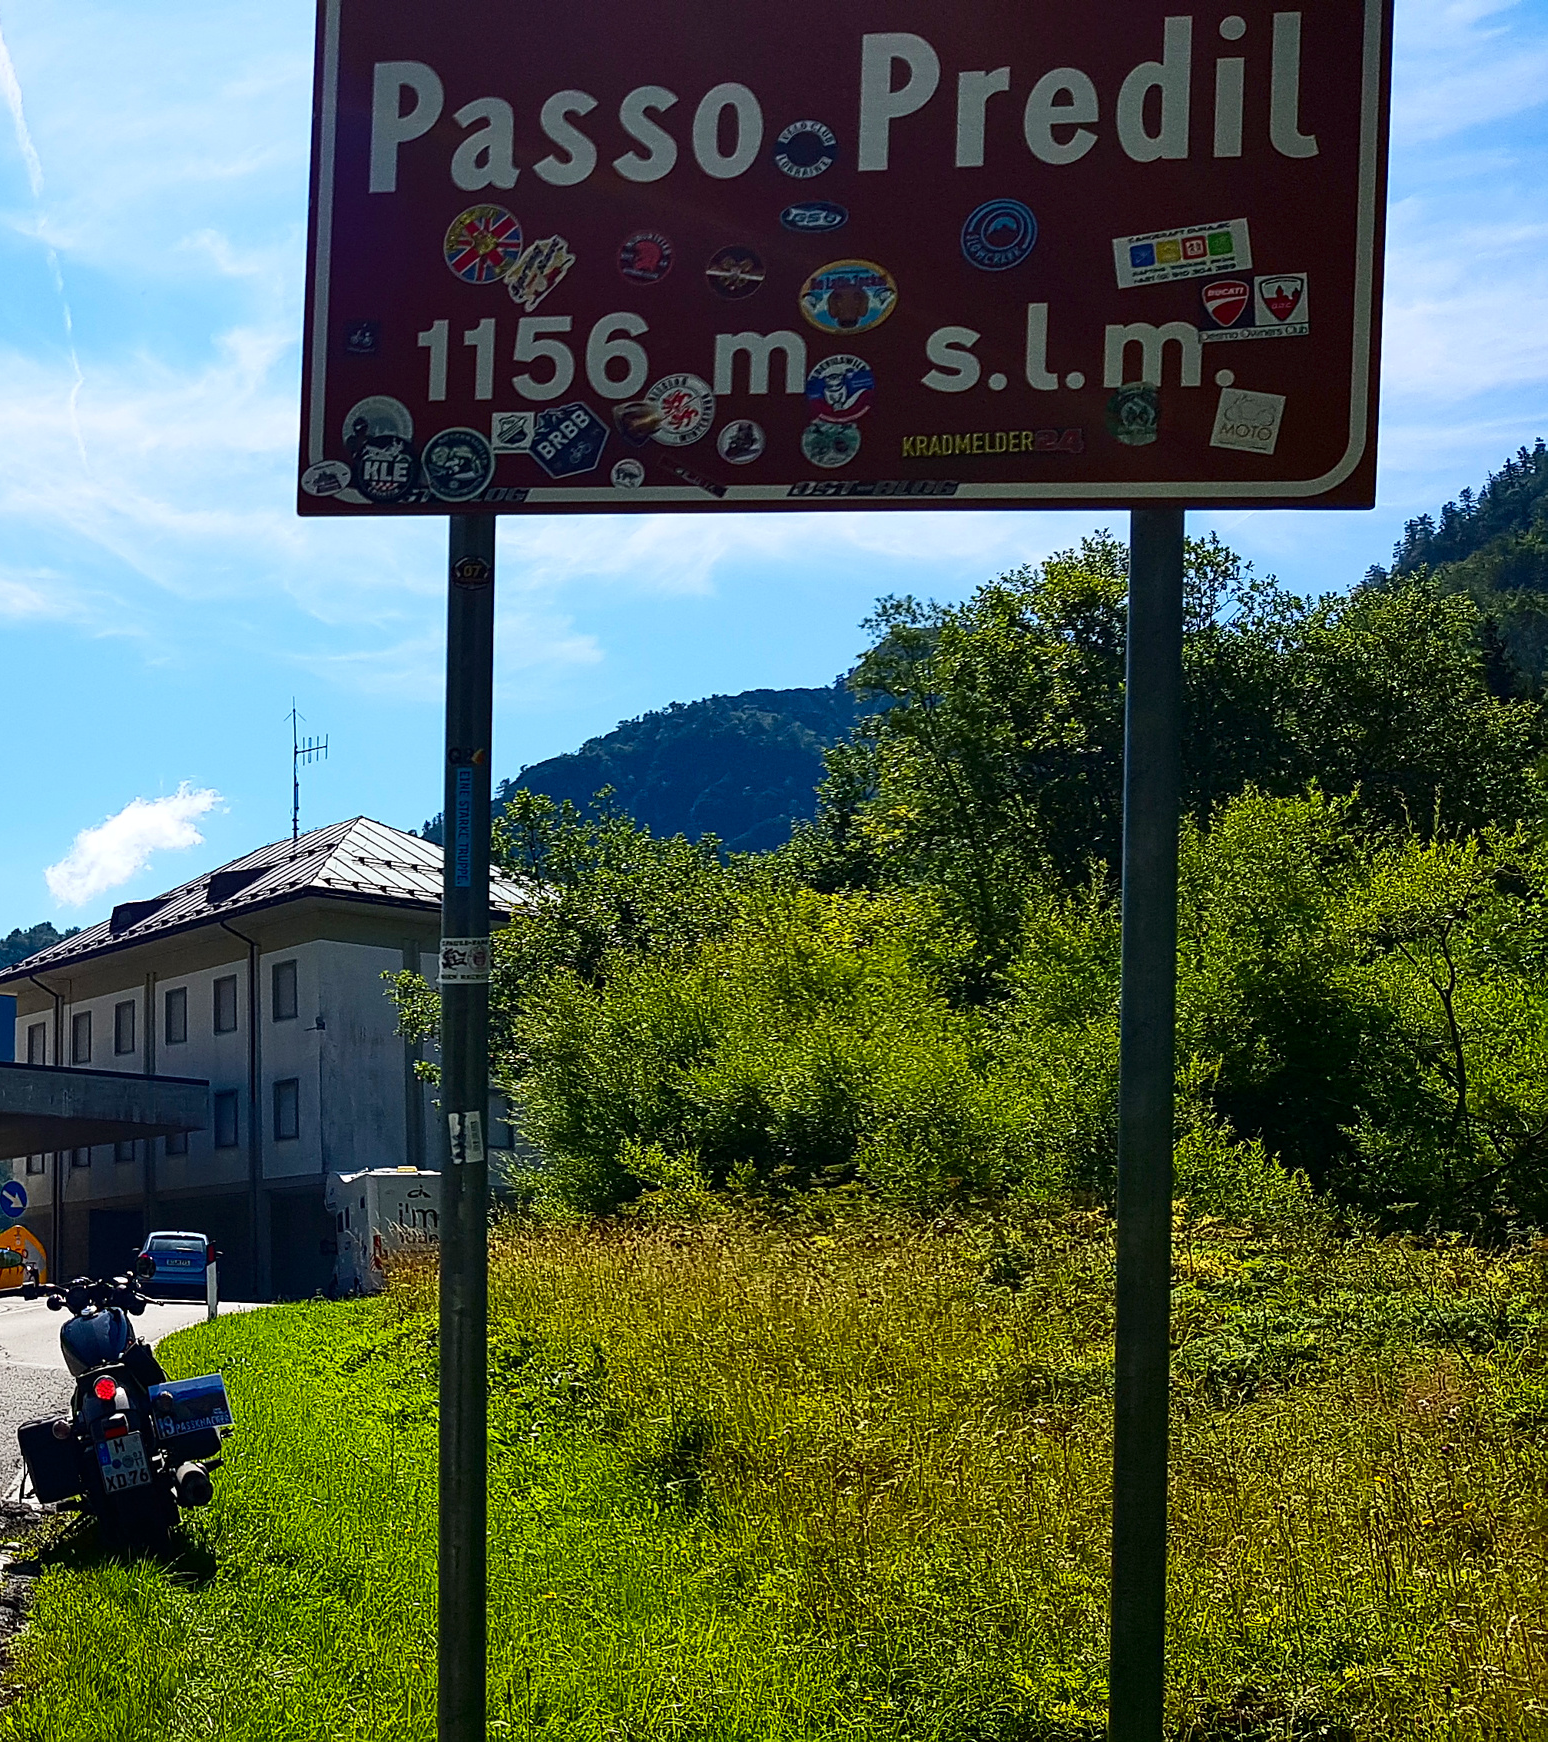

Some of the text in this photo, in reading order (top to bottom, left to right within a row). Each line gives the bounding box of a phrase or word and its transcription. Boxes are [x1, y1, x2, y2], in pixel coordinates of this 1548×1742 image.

[368, 10, 1320, 194] Passo Predil
[1206, 286, 1245, 297] DUCATI
[1239, 327, 1283, 339] Owners
[1284, 325, 1308, 335] Club
[417, 302, 1236, 402] 1156 m s.l.m.
[536, 409, 591, 461] BRBB
[1219, 422, 1272, 441] MOTO
[362, 459, 409, 483] KLE
[457, 800, 471, 840] STARKE
[175, 1413, 232, 1434] PASSKNACKER
[113, 1438, 126, 1454] M
